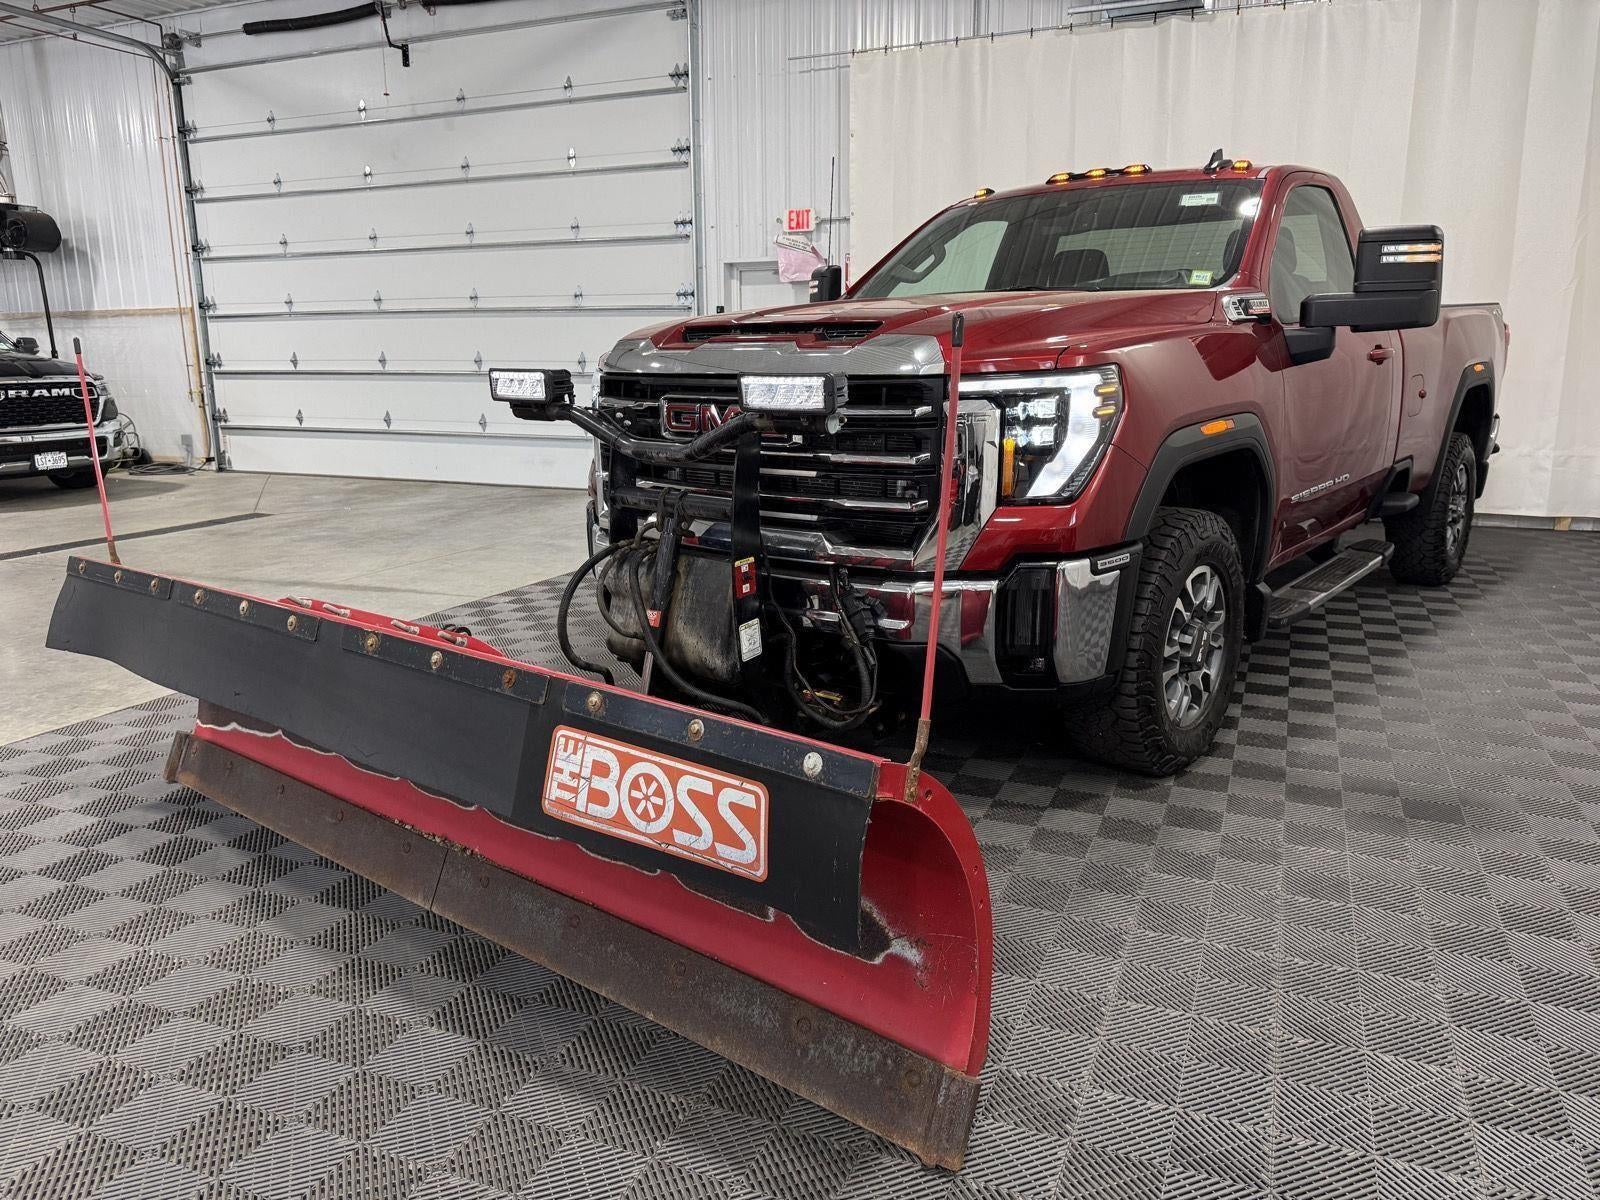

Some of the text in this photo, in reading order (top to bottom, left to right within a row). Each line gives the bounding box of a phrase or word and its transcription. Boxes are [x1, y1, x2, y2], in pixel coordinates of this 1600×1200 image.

[788, 209, 811, 230] EXIT
[8, 388, 70, 398] RAM
[665, 403, 758, 435] GM
[1291, 473, 1350, 504] SIERRA HD
[1099, 555, 1129, 567] 3500
[550, 737, 583, 803] THE
[576, 744, 757, 864] BOSS
